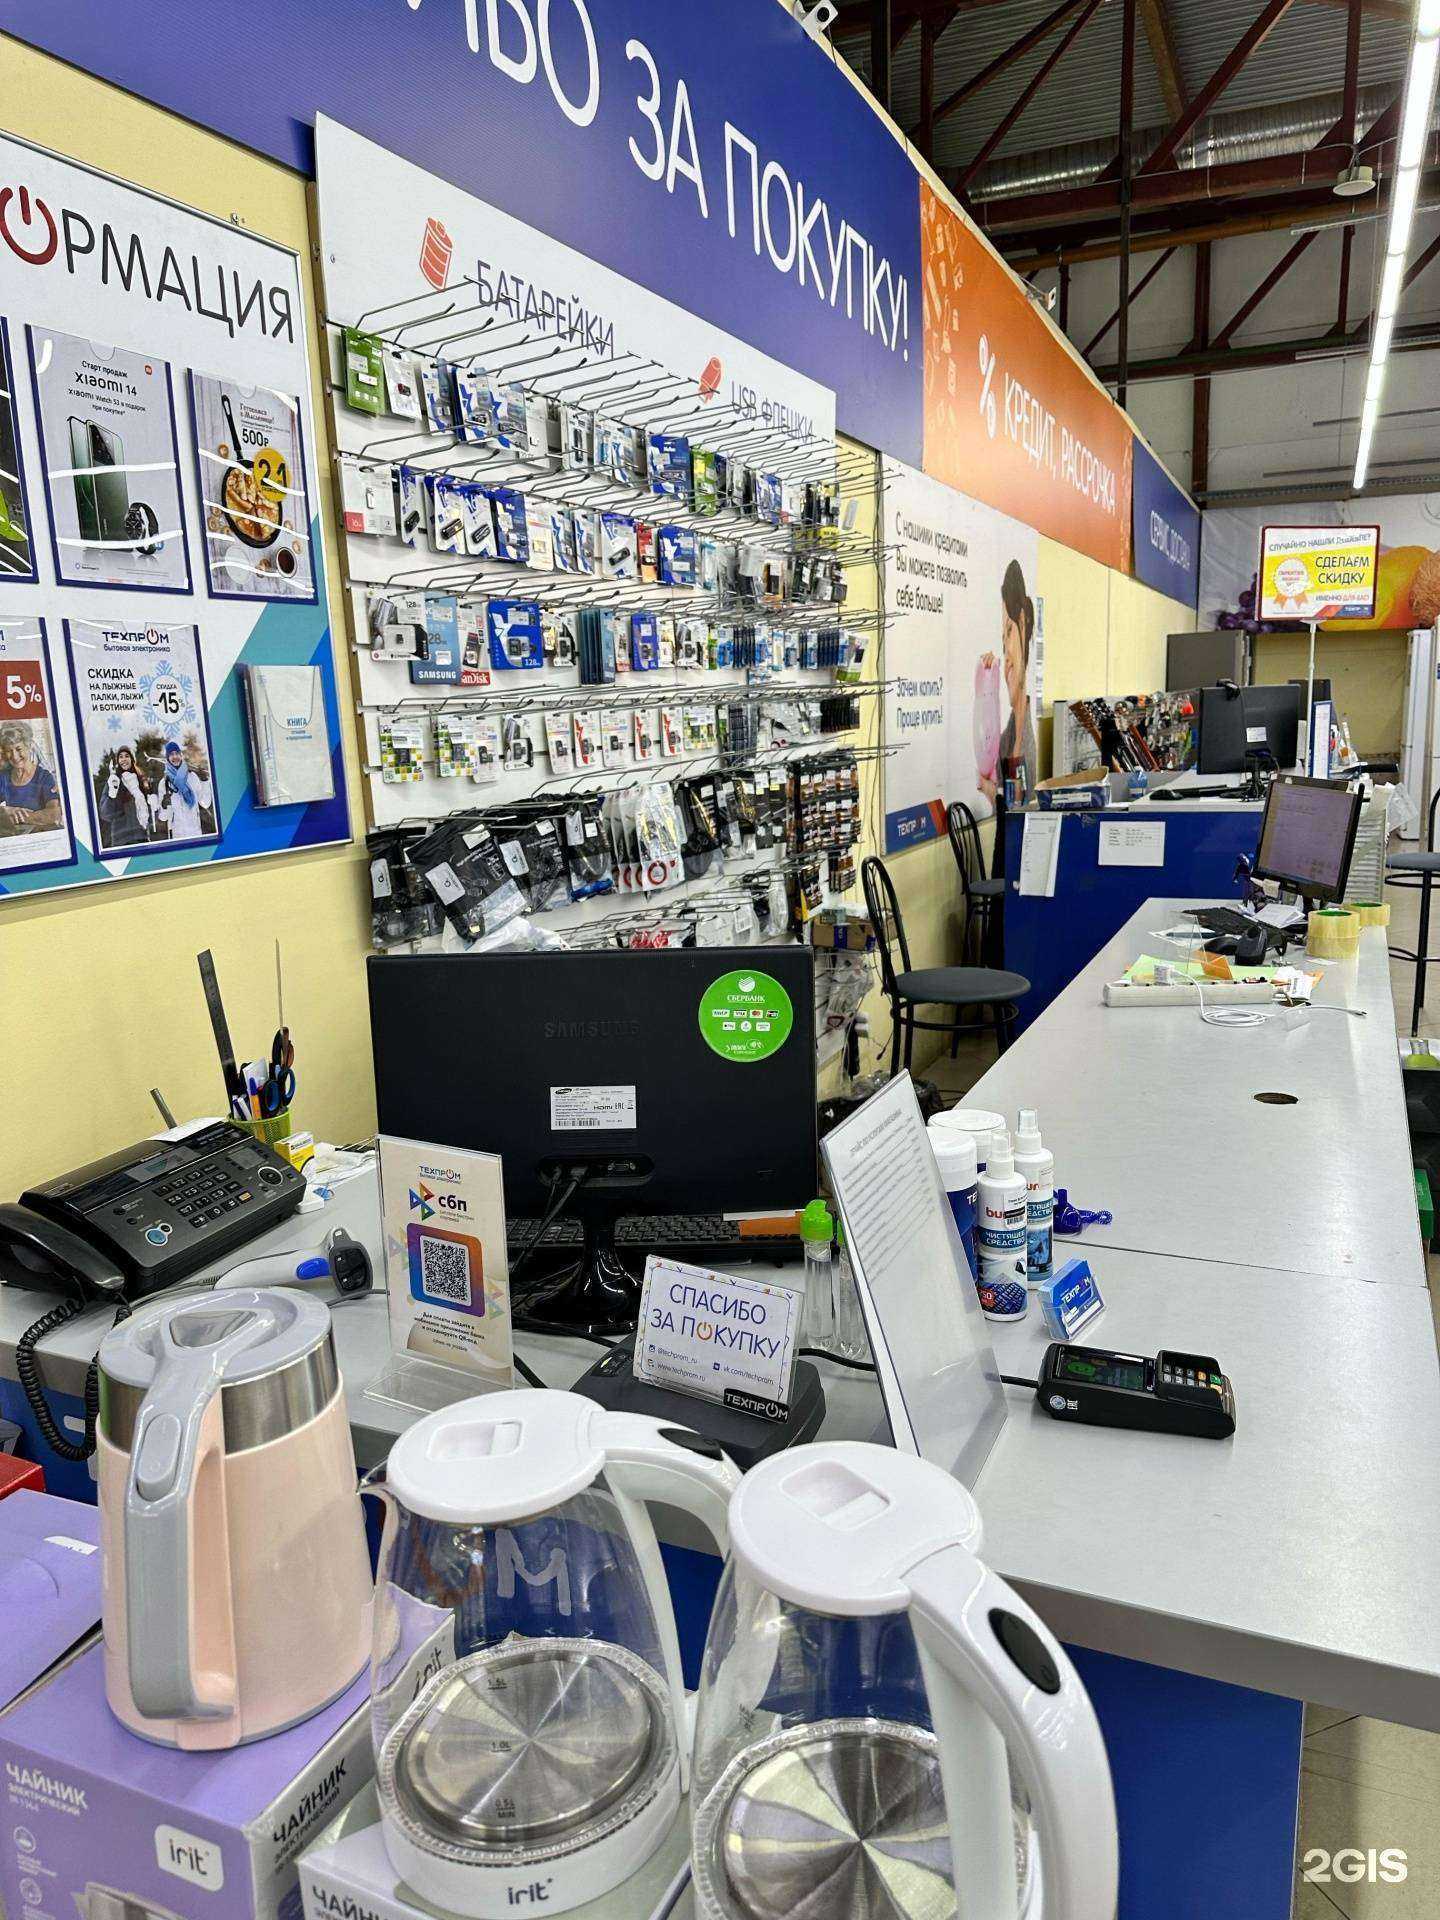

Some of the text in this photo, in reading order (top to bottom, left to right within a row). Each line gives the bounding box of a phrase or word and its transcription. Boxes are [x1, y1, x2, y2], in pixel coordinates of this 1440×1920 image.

[625, 38, 709, 218] ЗА
[724, 121, 909, 361] ПОКУПКУ!
[477, 259, 614, 361] БАТАРЕЙКИ
[125, 385, 137, 396] 14
[1061, 427, 1116, 516] РАССРОЧКА
[896, 511, 902, 536] С
[896, 547, 907, 574] Вы
[909, 557, 936, 580] можете
[1315, 556, 1370, 569] СДЕЛАЕМ
[1318, 572, 1365, 585] СКИДКУ
[896, 585, 914, 608] себе
[88, 668, 134, 680] СКИДКА
[102, 682, 136, 690] ЛЫЖНЫЕ
[418, 670, 457, 679] SAMSUNG
[462, 673, 489, 684] anDisk
[438, 1194, 467, 1212] сбп
[669, 1283, 767, 1325] СПАСИБО
[650, 1308, 781, 1359] ЗА ПОКУПКУ
[725, 1392, 788, 1420] ТЕХПРОМ
[6, 1761, 88, 1810] ЧАЙНИК
[273, 1758, 347, 1843] ЧАЙНИК
[508, 1879, 550, 1905] irit
